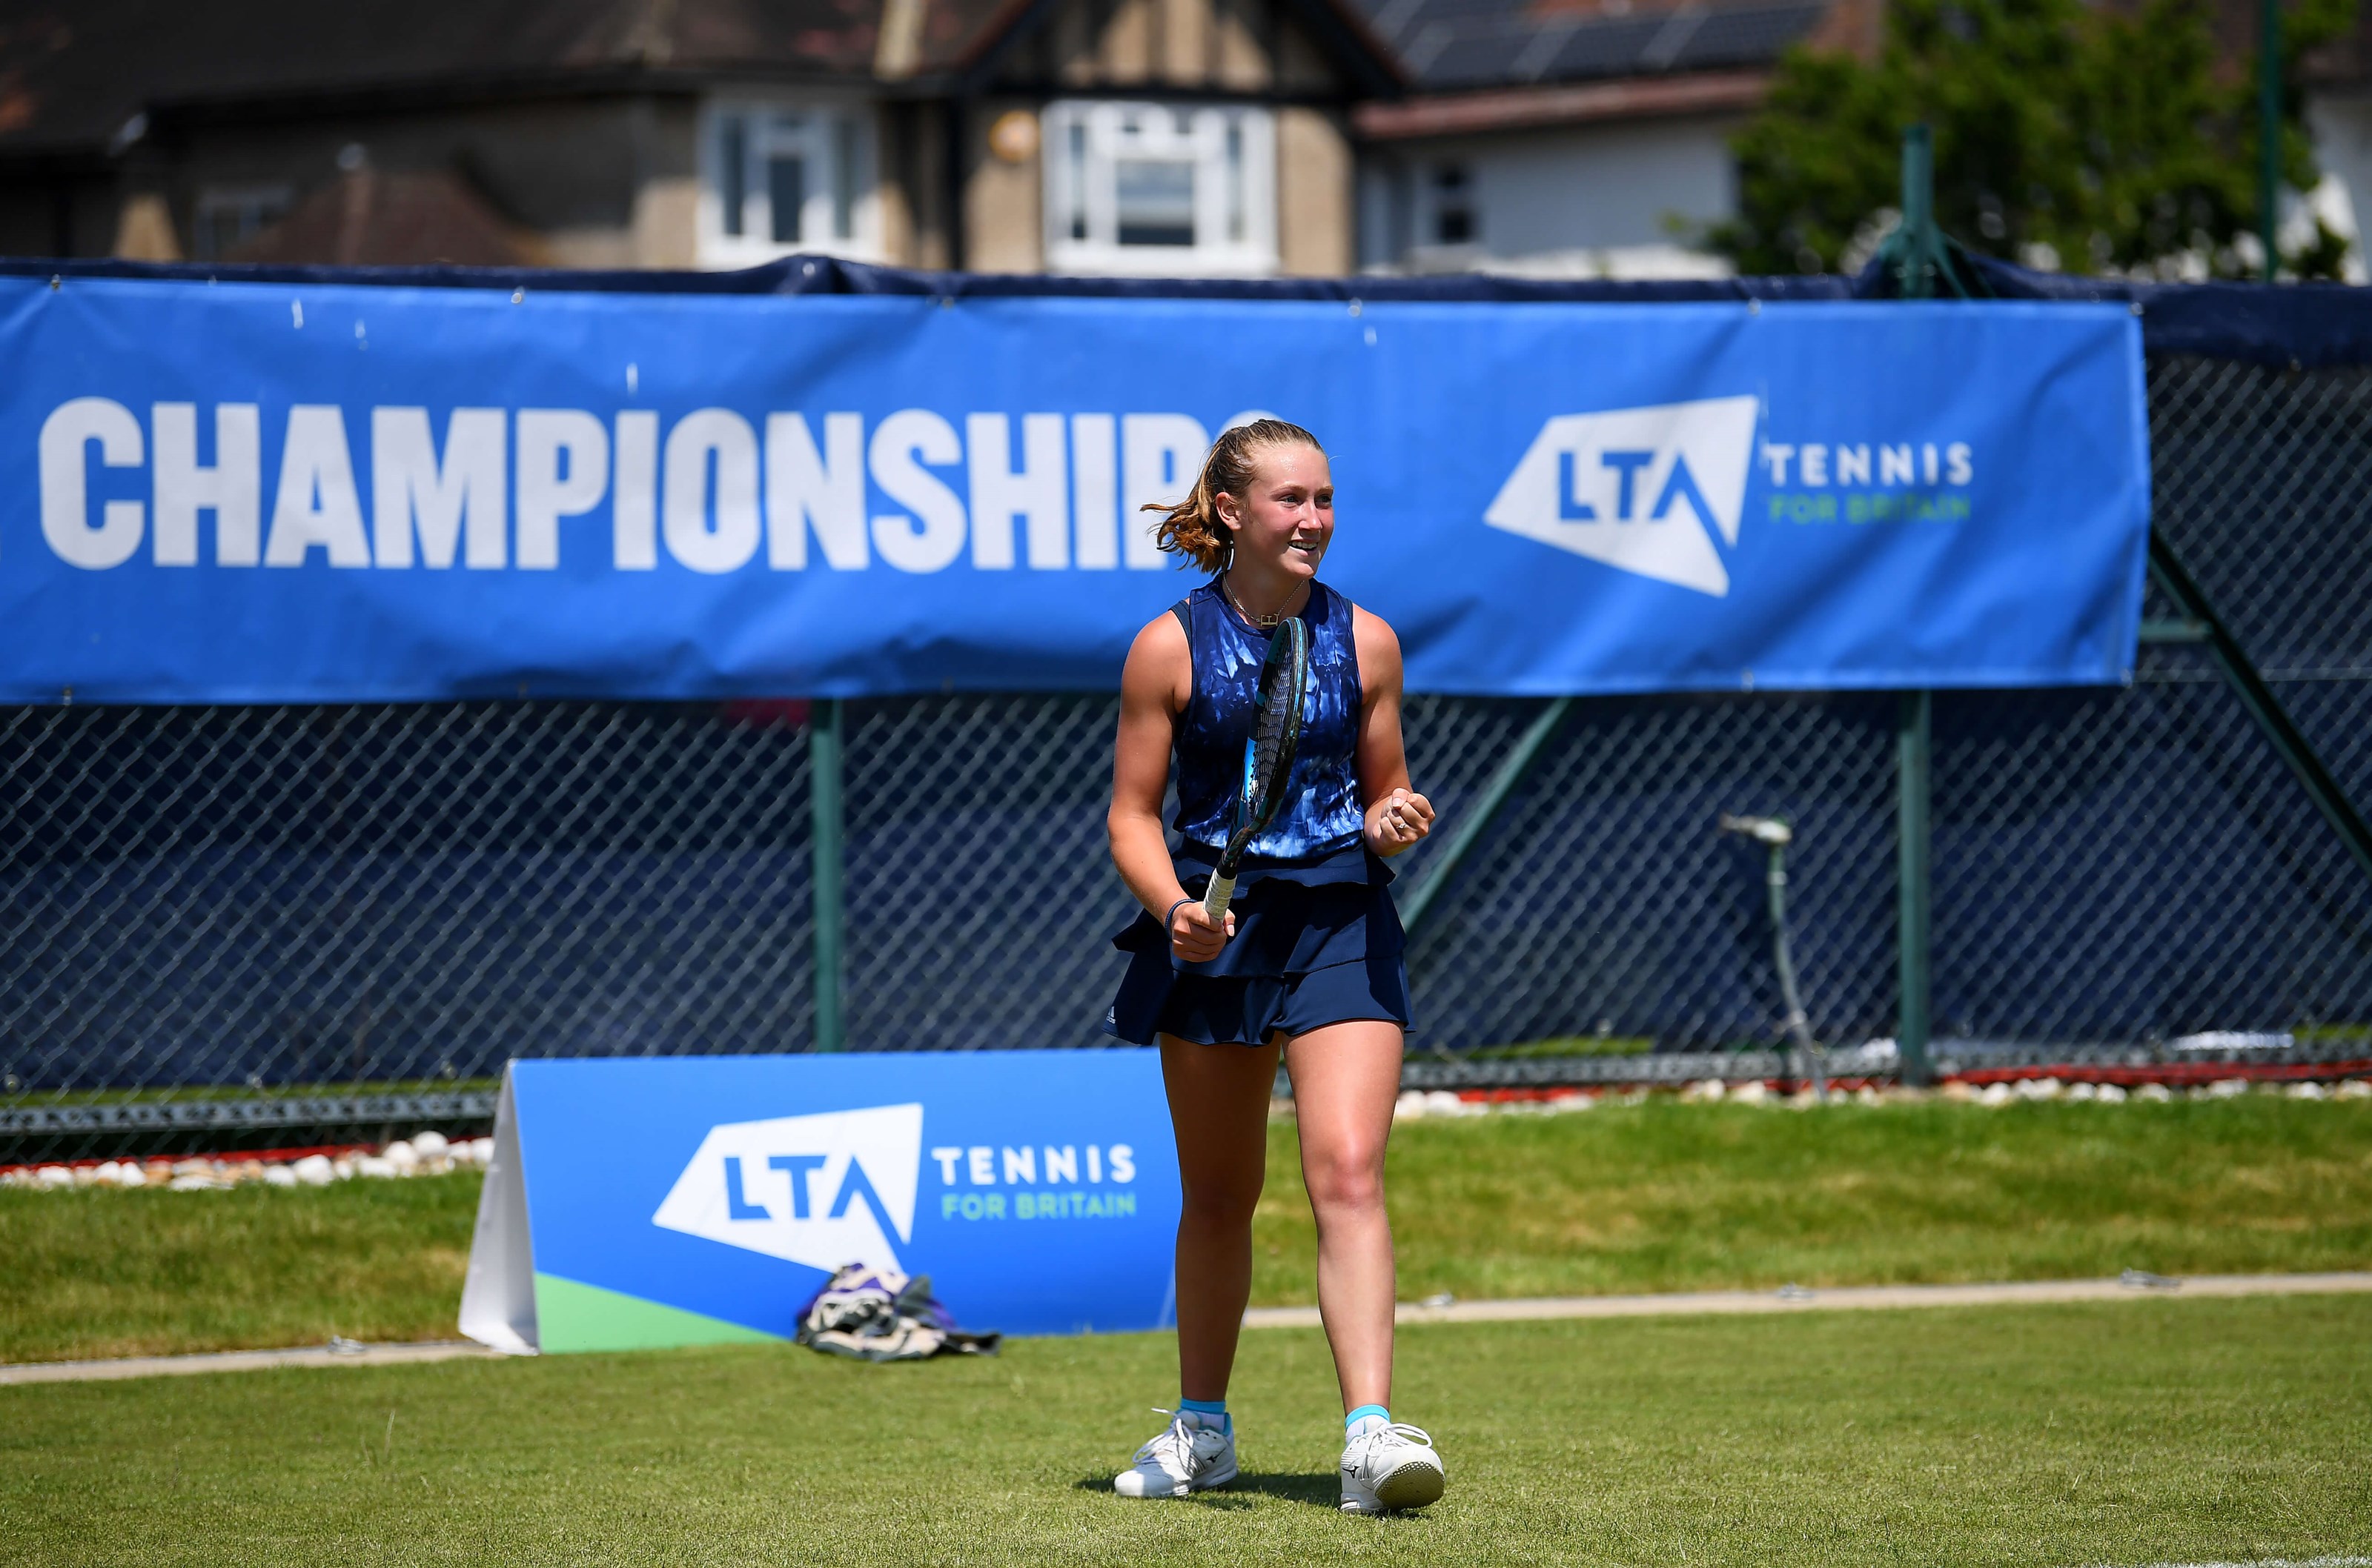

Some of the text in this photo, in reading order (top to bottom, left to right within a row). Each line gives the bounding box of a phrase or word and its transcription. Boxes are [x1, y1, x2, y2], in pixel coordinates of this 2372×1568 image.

[39, 396, 1287, 574] CHAMPIONSHIP
[1766, 442, 1972, 487] TENNIS
[1558, 449, 1732, 547] LTA
[1769, 492, 1970, 525] FOR BRITAIN
[931, 1143, 1136, 1186] TENNIS
[723, 1155, 909, 1239] LTA
[941, 1190, 1136, 1220] FOR BRITAIN
